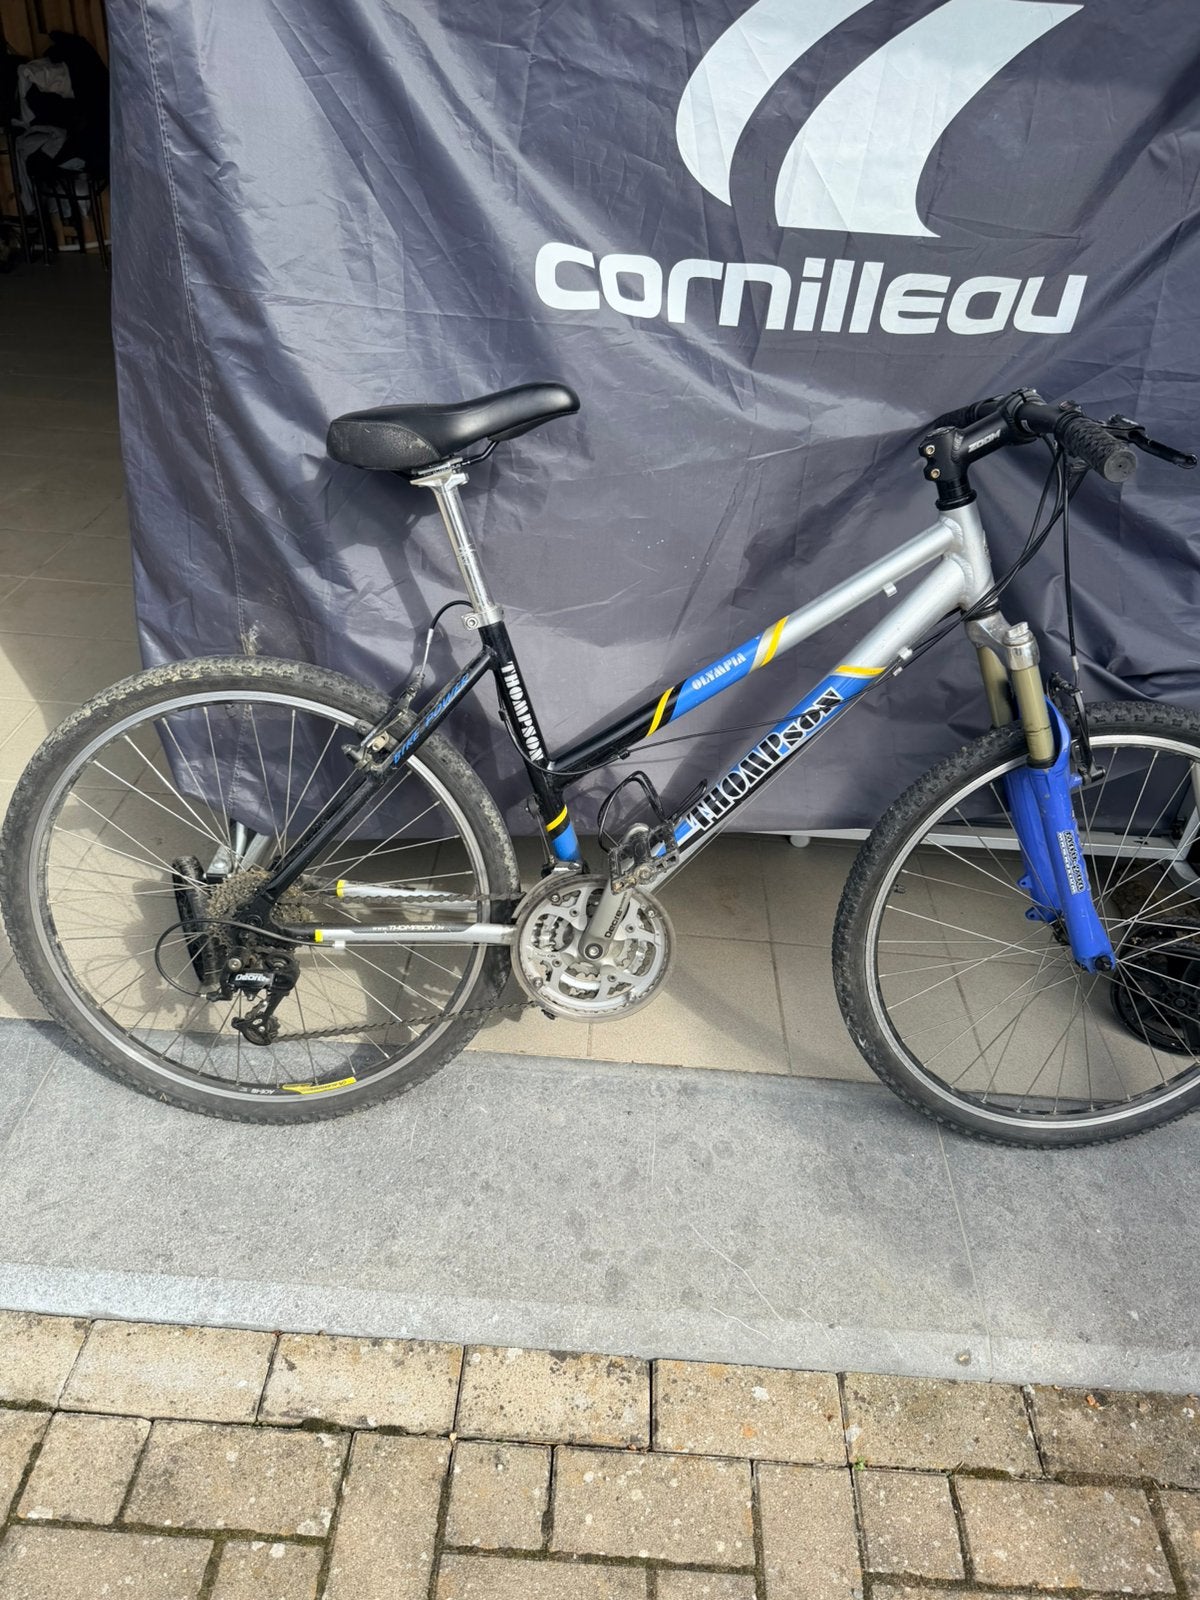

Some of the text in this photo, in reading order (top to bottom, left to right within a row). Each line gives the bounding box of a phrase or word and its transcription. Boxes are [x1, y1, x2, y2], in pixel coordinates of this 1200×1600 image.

[535, 241, 1088, 334] cornilleau
[967, 428, 1002, 453] ZOOM
[501, 660, 544, 761] THOMPSON
[691, 652, 747, 690] OLYMPIA
[393, 672, 470, 764] BIKE POWER
[685, 686, 844, 831] THOMPSON
